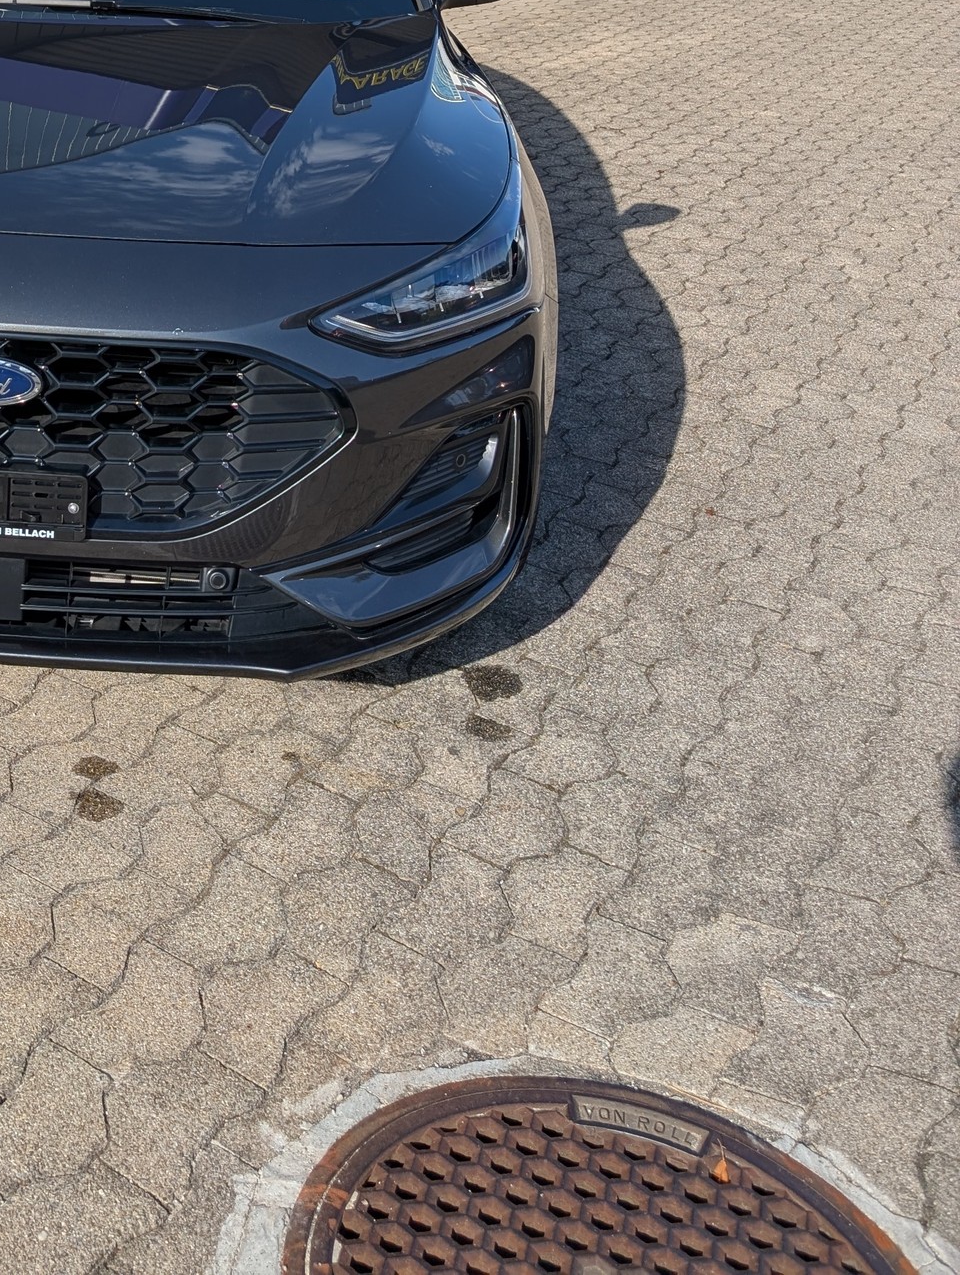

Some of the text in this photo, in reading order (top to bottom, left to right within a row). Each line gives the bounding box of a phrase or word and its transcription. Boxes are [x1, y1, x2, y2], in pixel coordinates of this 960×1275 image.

[4, 528, 55, 539] BELLACH
[582, 1105, 698, 1145] VON ROLL
